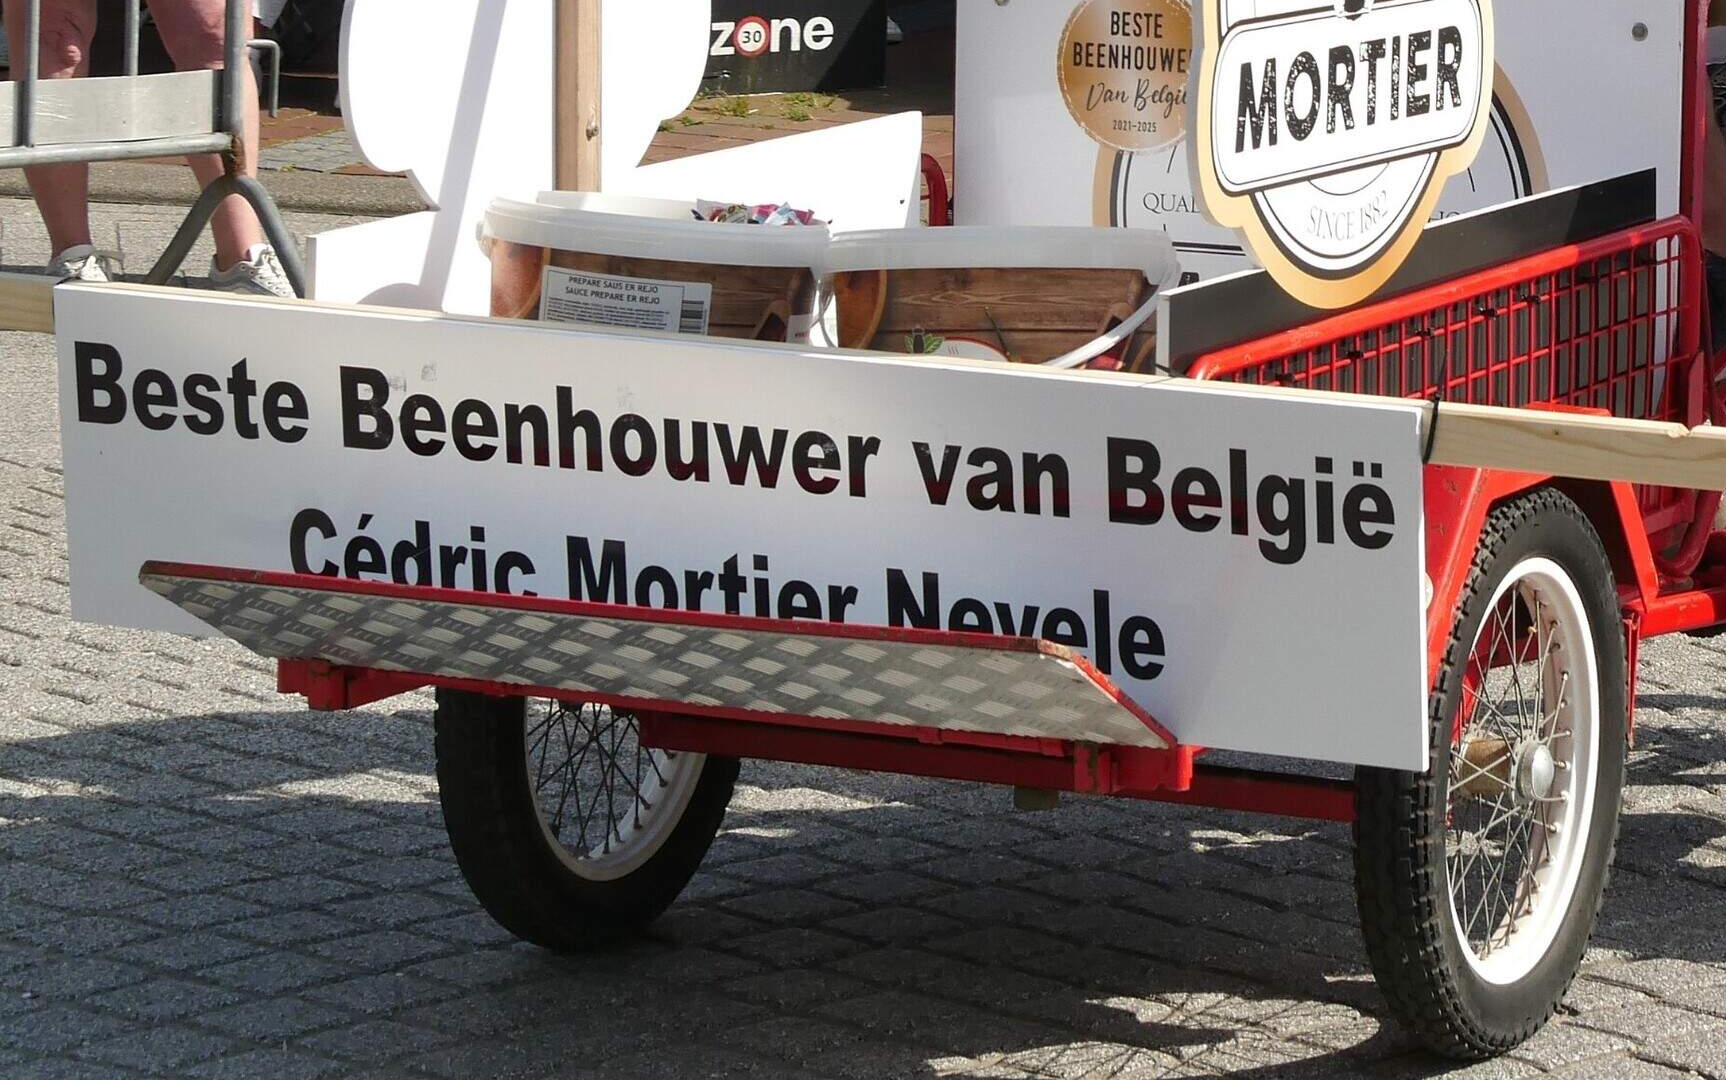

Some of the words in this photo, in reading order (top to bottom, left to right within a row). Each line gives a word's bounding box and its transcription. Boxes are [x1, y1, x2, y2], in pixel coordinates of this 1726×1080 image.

[1110, 11, 1164, 39] BESTE
[1072, 41, 1193, 74] BEENHOUWE
[1234, 25, 1463, 154] MORTIER
[1112, 119, 1158, 134] 2021-2025
[1306, 204, 1355, 241] SINCE
[74, 340, 310, 444] Beste
[339, 364, 881, 498] Beenhouwer
[911, 439, 1071, 519] van
[1106, 436, 1396, 565] België
[289, 507, 539, 596] Cédric
[566, 534, 860, 623] Mortier
[886, 567, 1167, 681] Nevele
